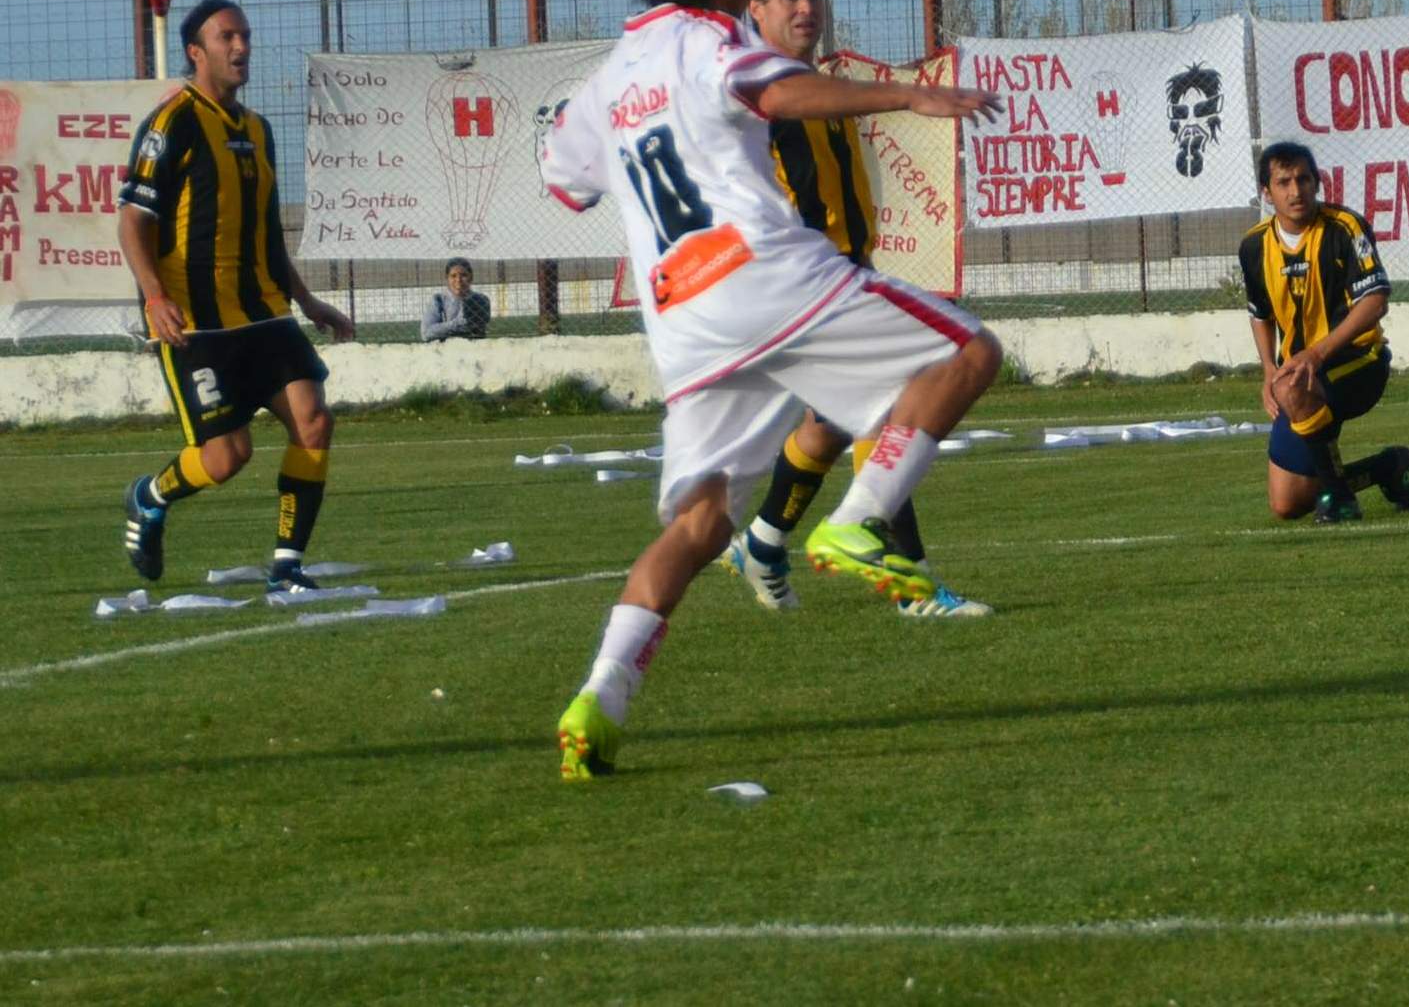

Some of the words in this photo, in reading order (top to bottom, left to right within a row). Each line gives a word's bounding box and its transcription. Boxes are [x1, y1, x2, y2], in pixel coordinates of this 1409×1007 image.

[335, 71, 387, 87] Solo
[974, 54, 1073, 92] HASTA
[453, 97, 494, 137] H
[1008, 94, 1049, 133] LA
[1096, 90, 1119, 117] H
[57, 114, 131, 139] EZE
[308, 148, 368, 168] Verte
[378, 150, 404, 167] Le
[856, 114, 948, 225] XTREMA
[971, 133, 1100, 175] VICTORIA
[310, 190, 336, 210] Da
[342, 188, 417, 209] Sentido
[619, 124, 713, 255] 10
[976, 174, 1086, 218] SIEMPRE
[192, 367, 222, 406] 2
